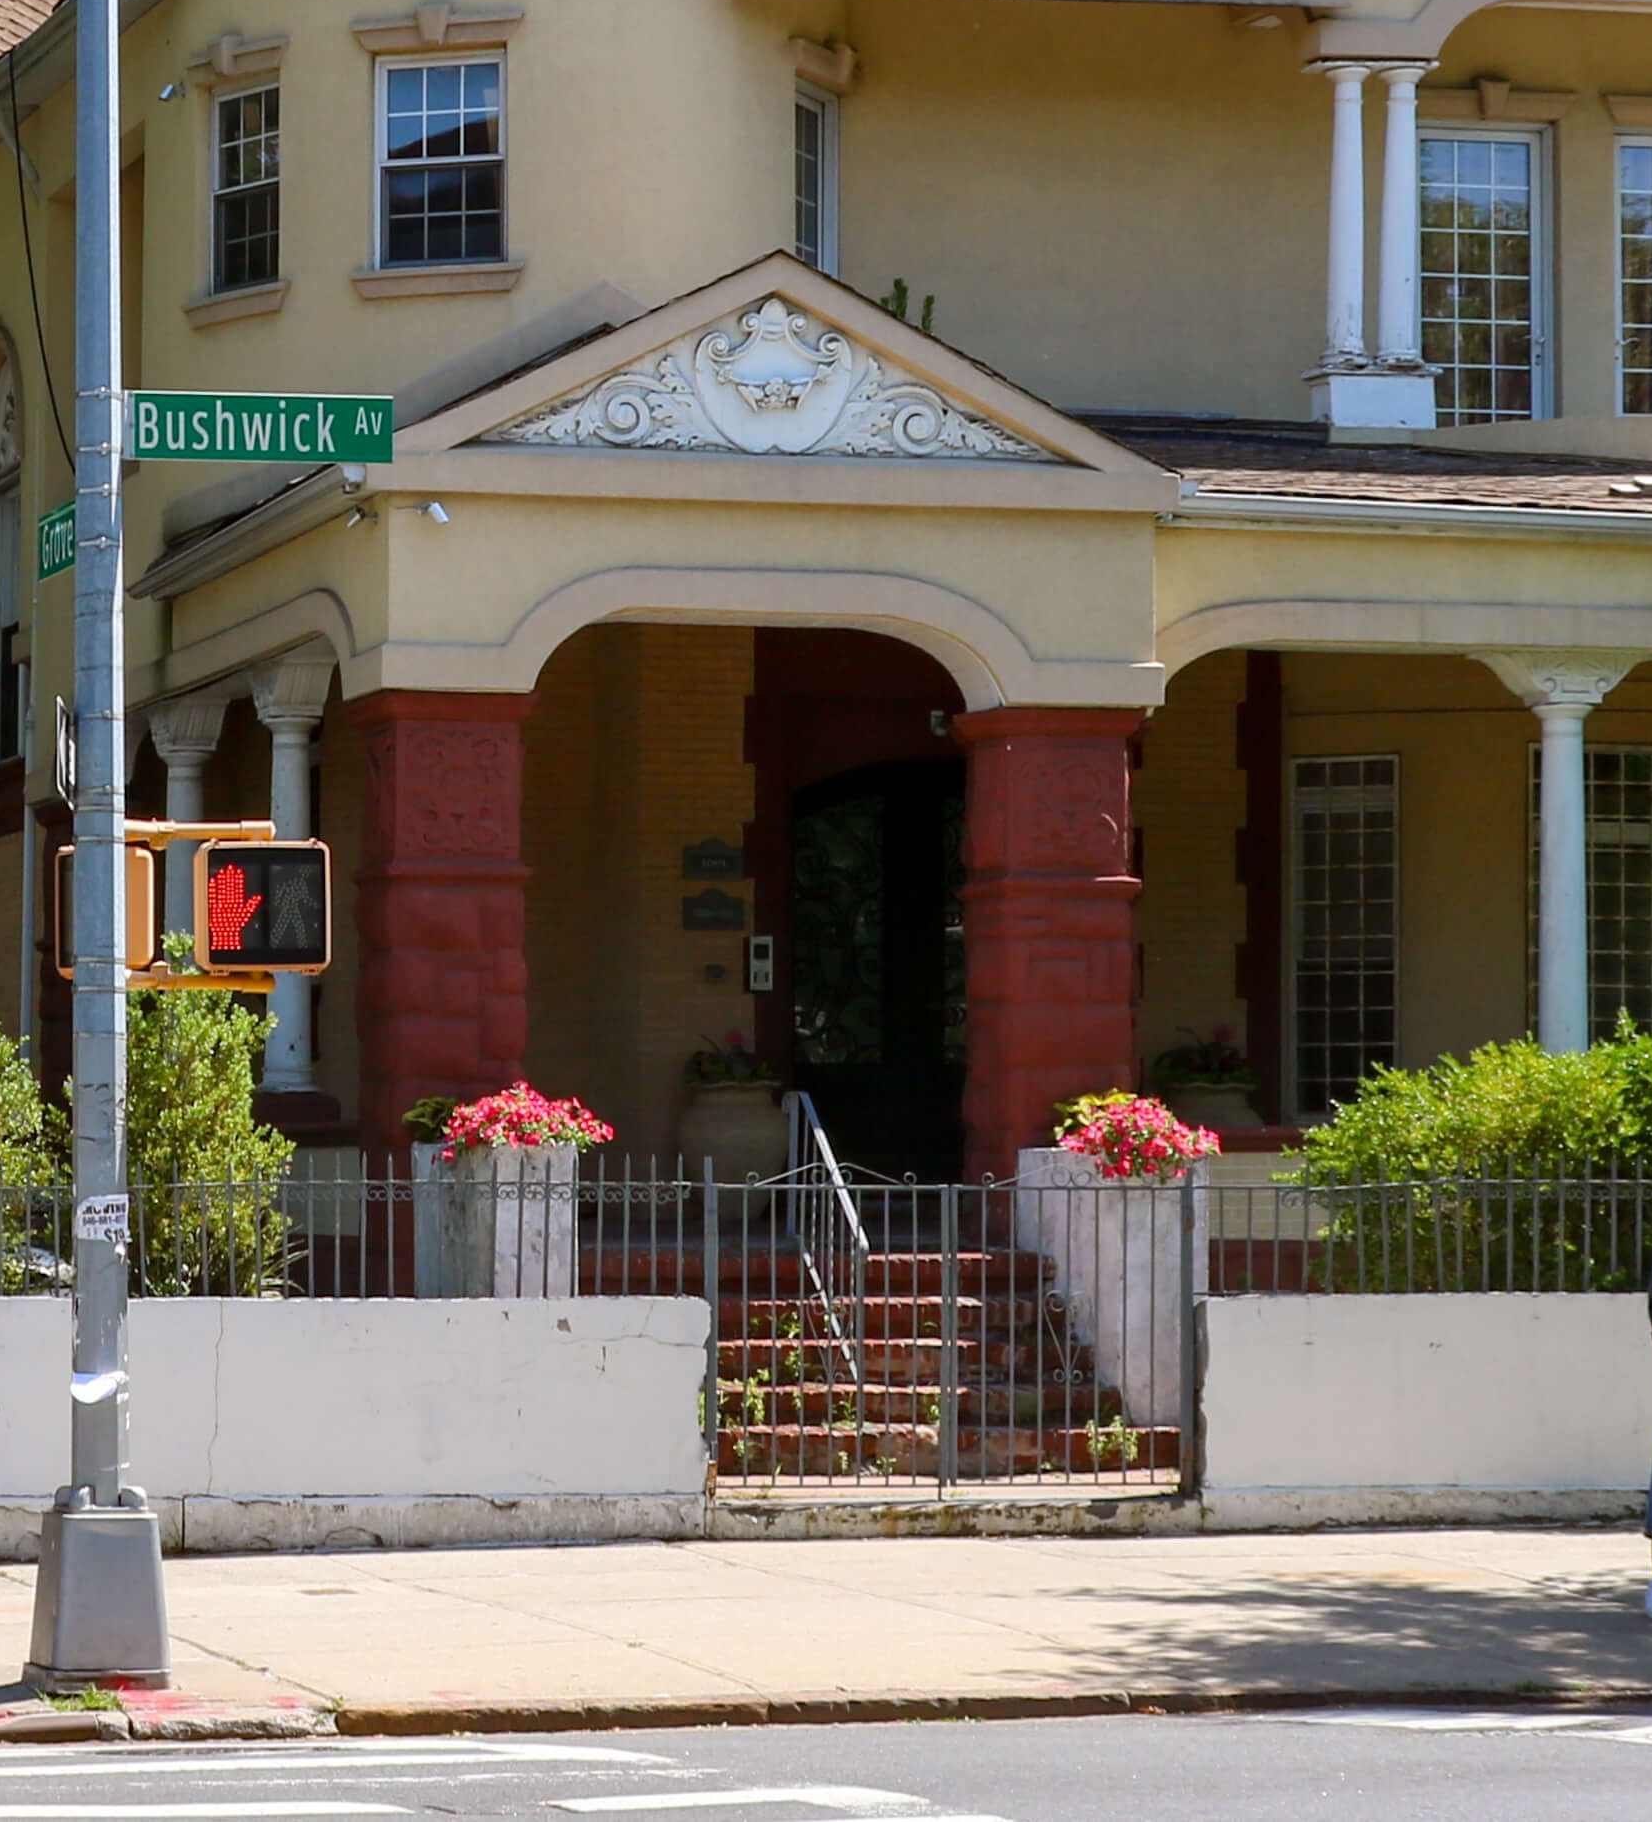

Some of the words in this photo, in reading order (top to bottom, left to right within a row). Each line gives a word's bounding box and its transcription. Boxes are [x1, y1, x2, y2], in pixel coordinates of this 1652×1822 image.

[138, 400, 336, 453] Bushwick
[355, 406, 383, 436] Av
[42, 518, 74, 570] Grove
